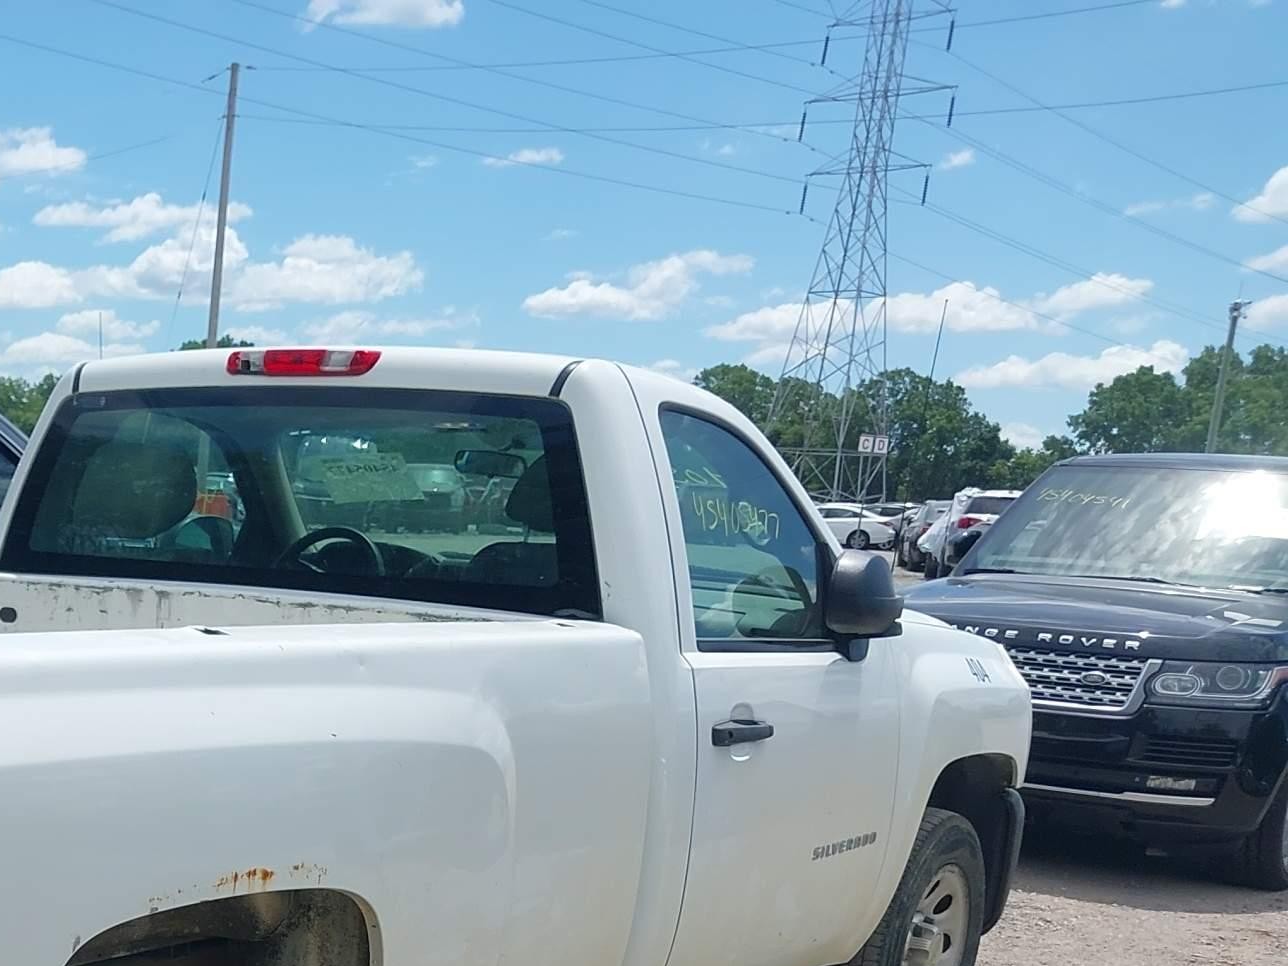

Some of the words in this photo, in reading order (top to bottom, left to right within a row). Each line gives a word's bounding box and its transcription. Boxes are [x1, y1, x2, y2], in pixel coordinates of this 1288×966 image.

[862, 438, 870, 450] C
[877, 440, 886, 451] D
[1037, 632, 1141, 651] ROVER
[812, 831, 877, 861] SILVERADO
